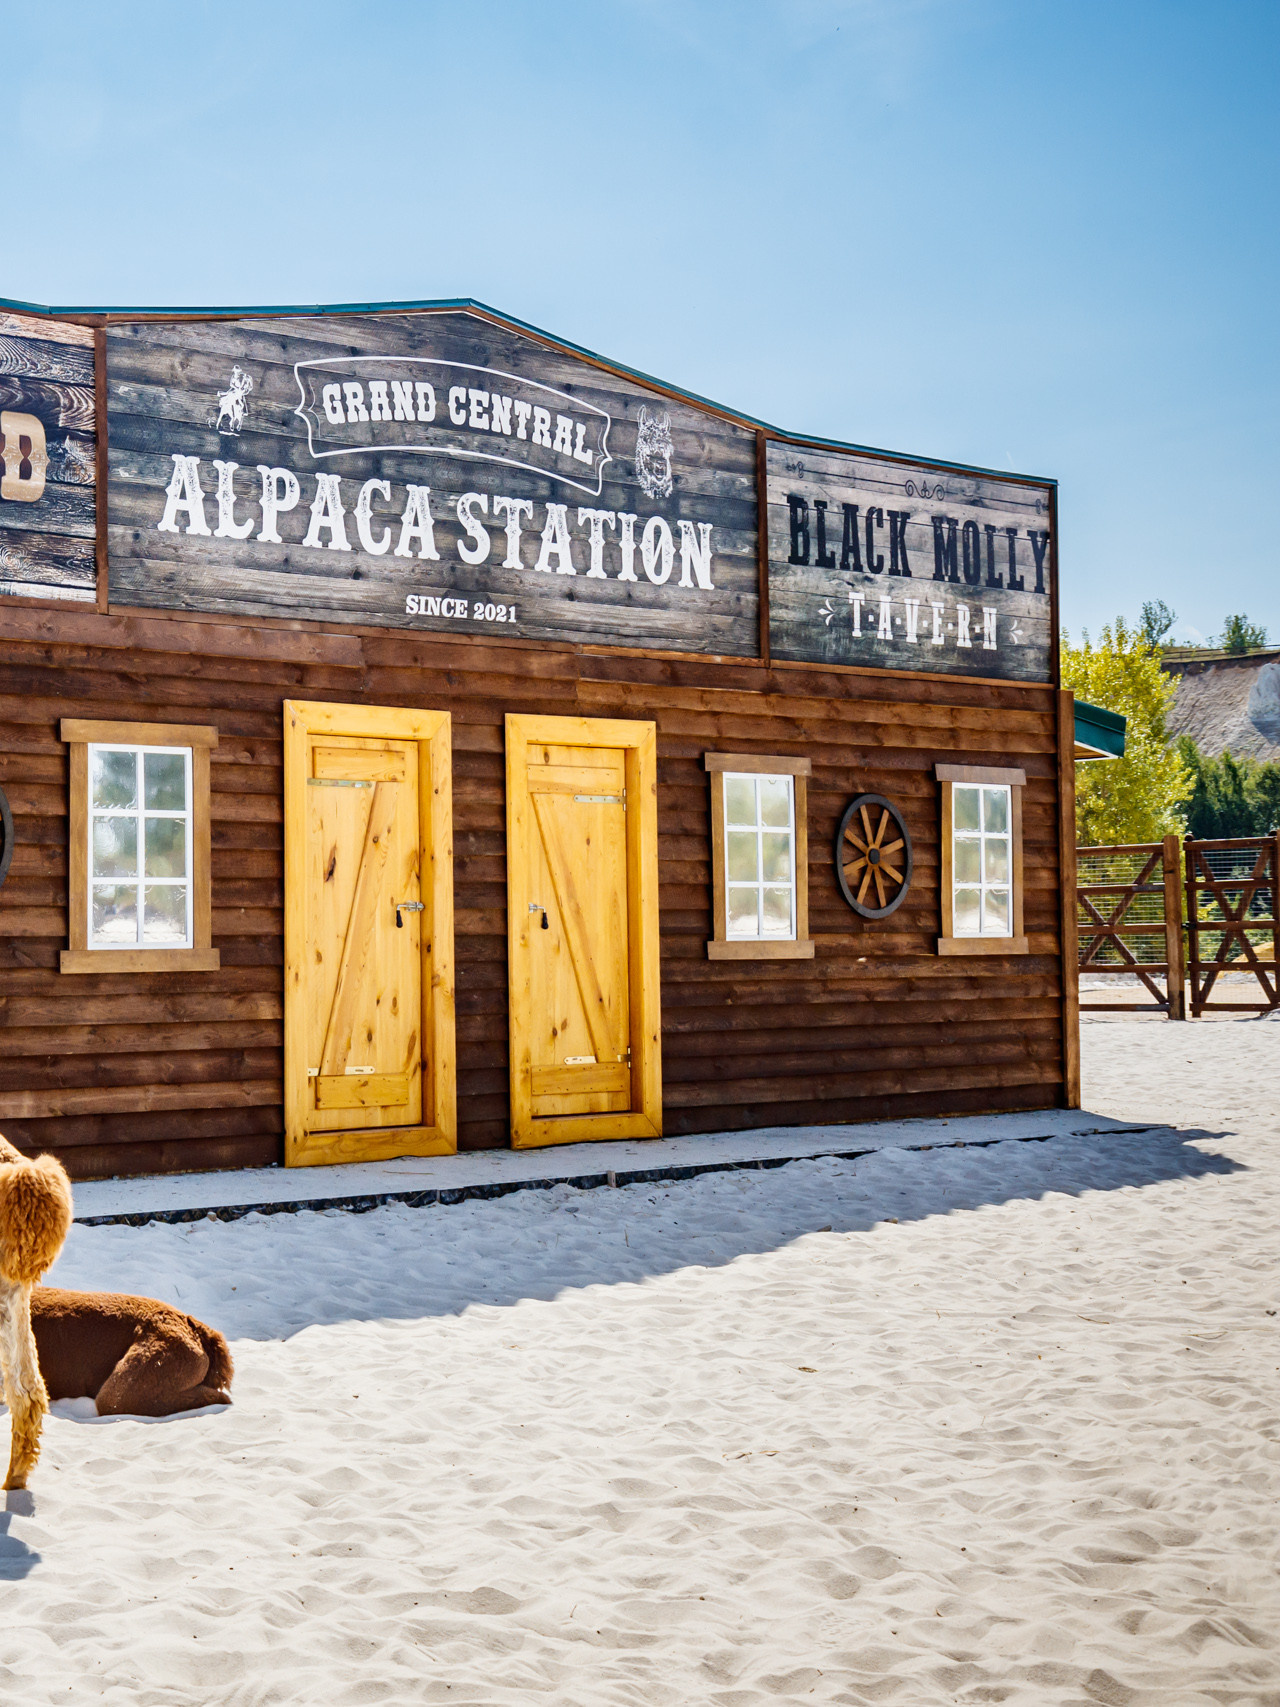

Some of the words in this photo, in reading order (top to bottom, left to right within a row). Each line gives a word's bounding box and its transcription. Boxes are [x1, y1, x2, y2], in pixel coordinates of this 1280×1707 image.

[322, 380, 437, 426] GRAND
[447, 387, 594, 464] CENTRAL
[157, 453, 440, 561] ALPACA
[456, 492, 715, 591] STATION
[787, 496, 912, 577] BLACK
[931, 516, 1050, 594] MOLLY
[405, 595, 468, 621] SINCE
[473, 602, 517, 625] 2021
